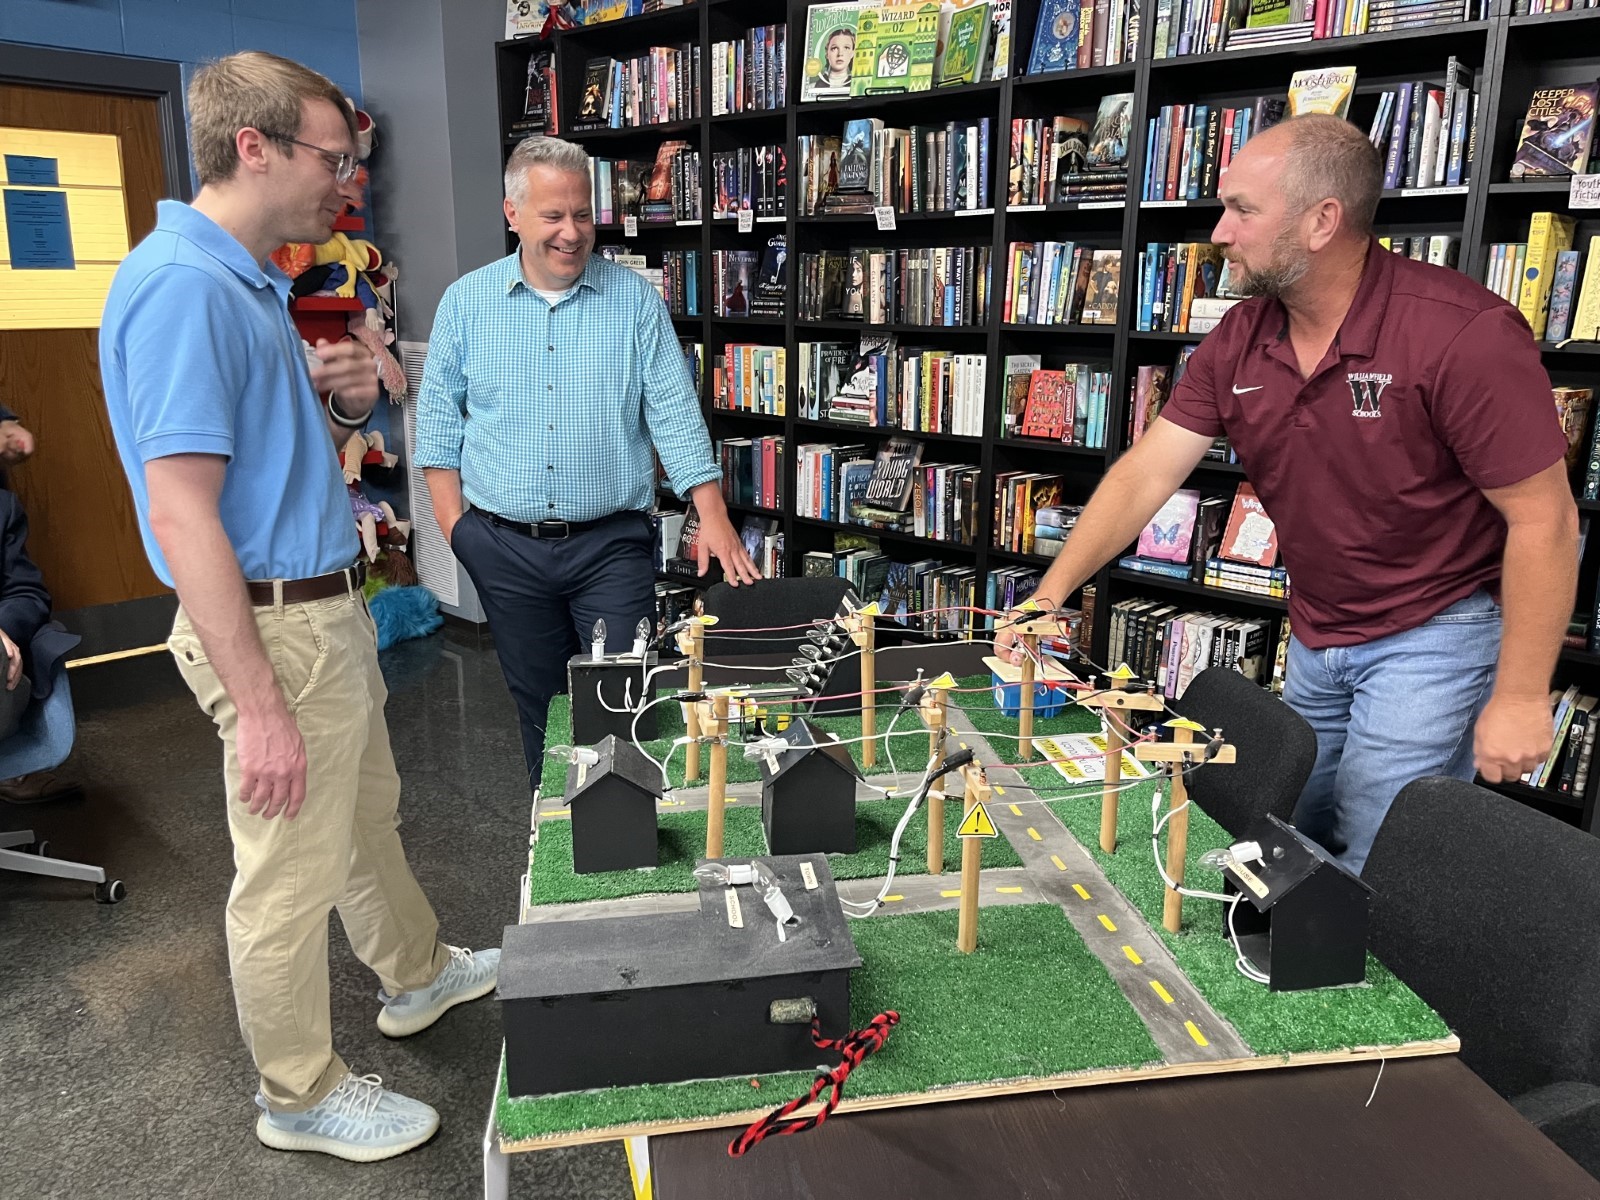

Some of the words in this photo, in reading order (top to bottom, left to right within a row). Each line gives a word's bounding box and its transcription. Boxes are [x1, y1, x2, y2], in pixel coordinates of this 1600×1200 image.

[881, 10, 914, 22] WIZARD
[892, 22, 905, 34] OZ
[1533, 88, 1574, 98] KEEPER
[1528, 106, 1563, 116] CITIES
[1530, 98, 1560, 108] LOST
[1468, 126, 1476, 162] STARDUST
[832, 356, 846, 364] FIRE
[1346, 380, 1392, 412] W
[1352, 410, 1381, 418] SCHOOLS
[876, 460, 910, 481] YOUNG
[866, 479, 905, 499] WORLD
[804, 866, 814, 886] TOWN
[1229, 860, 1254, 883] HOUSE
[728, 895, 738, 924] SCHOOL
